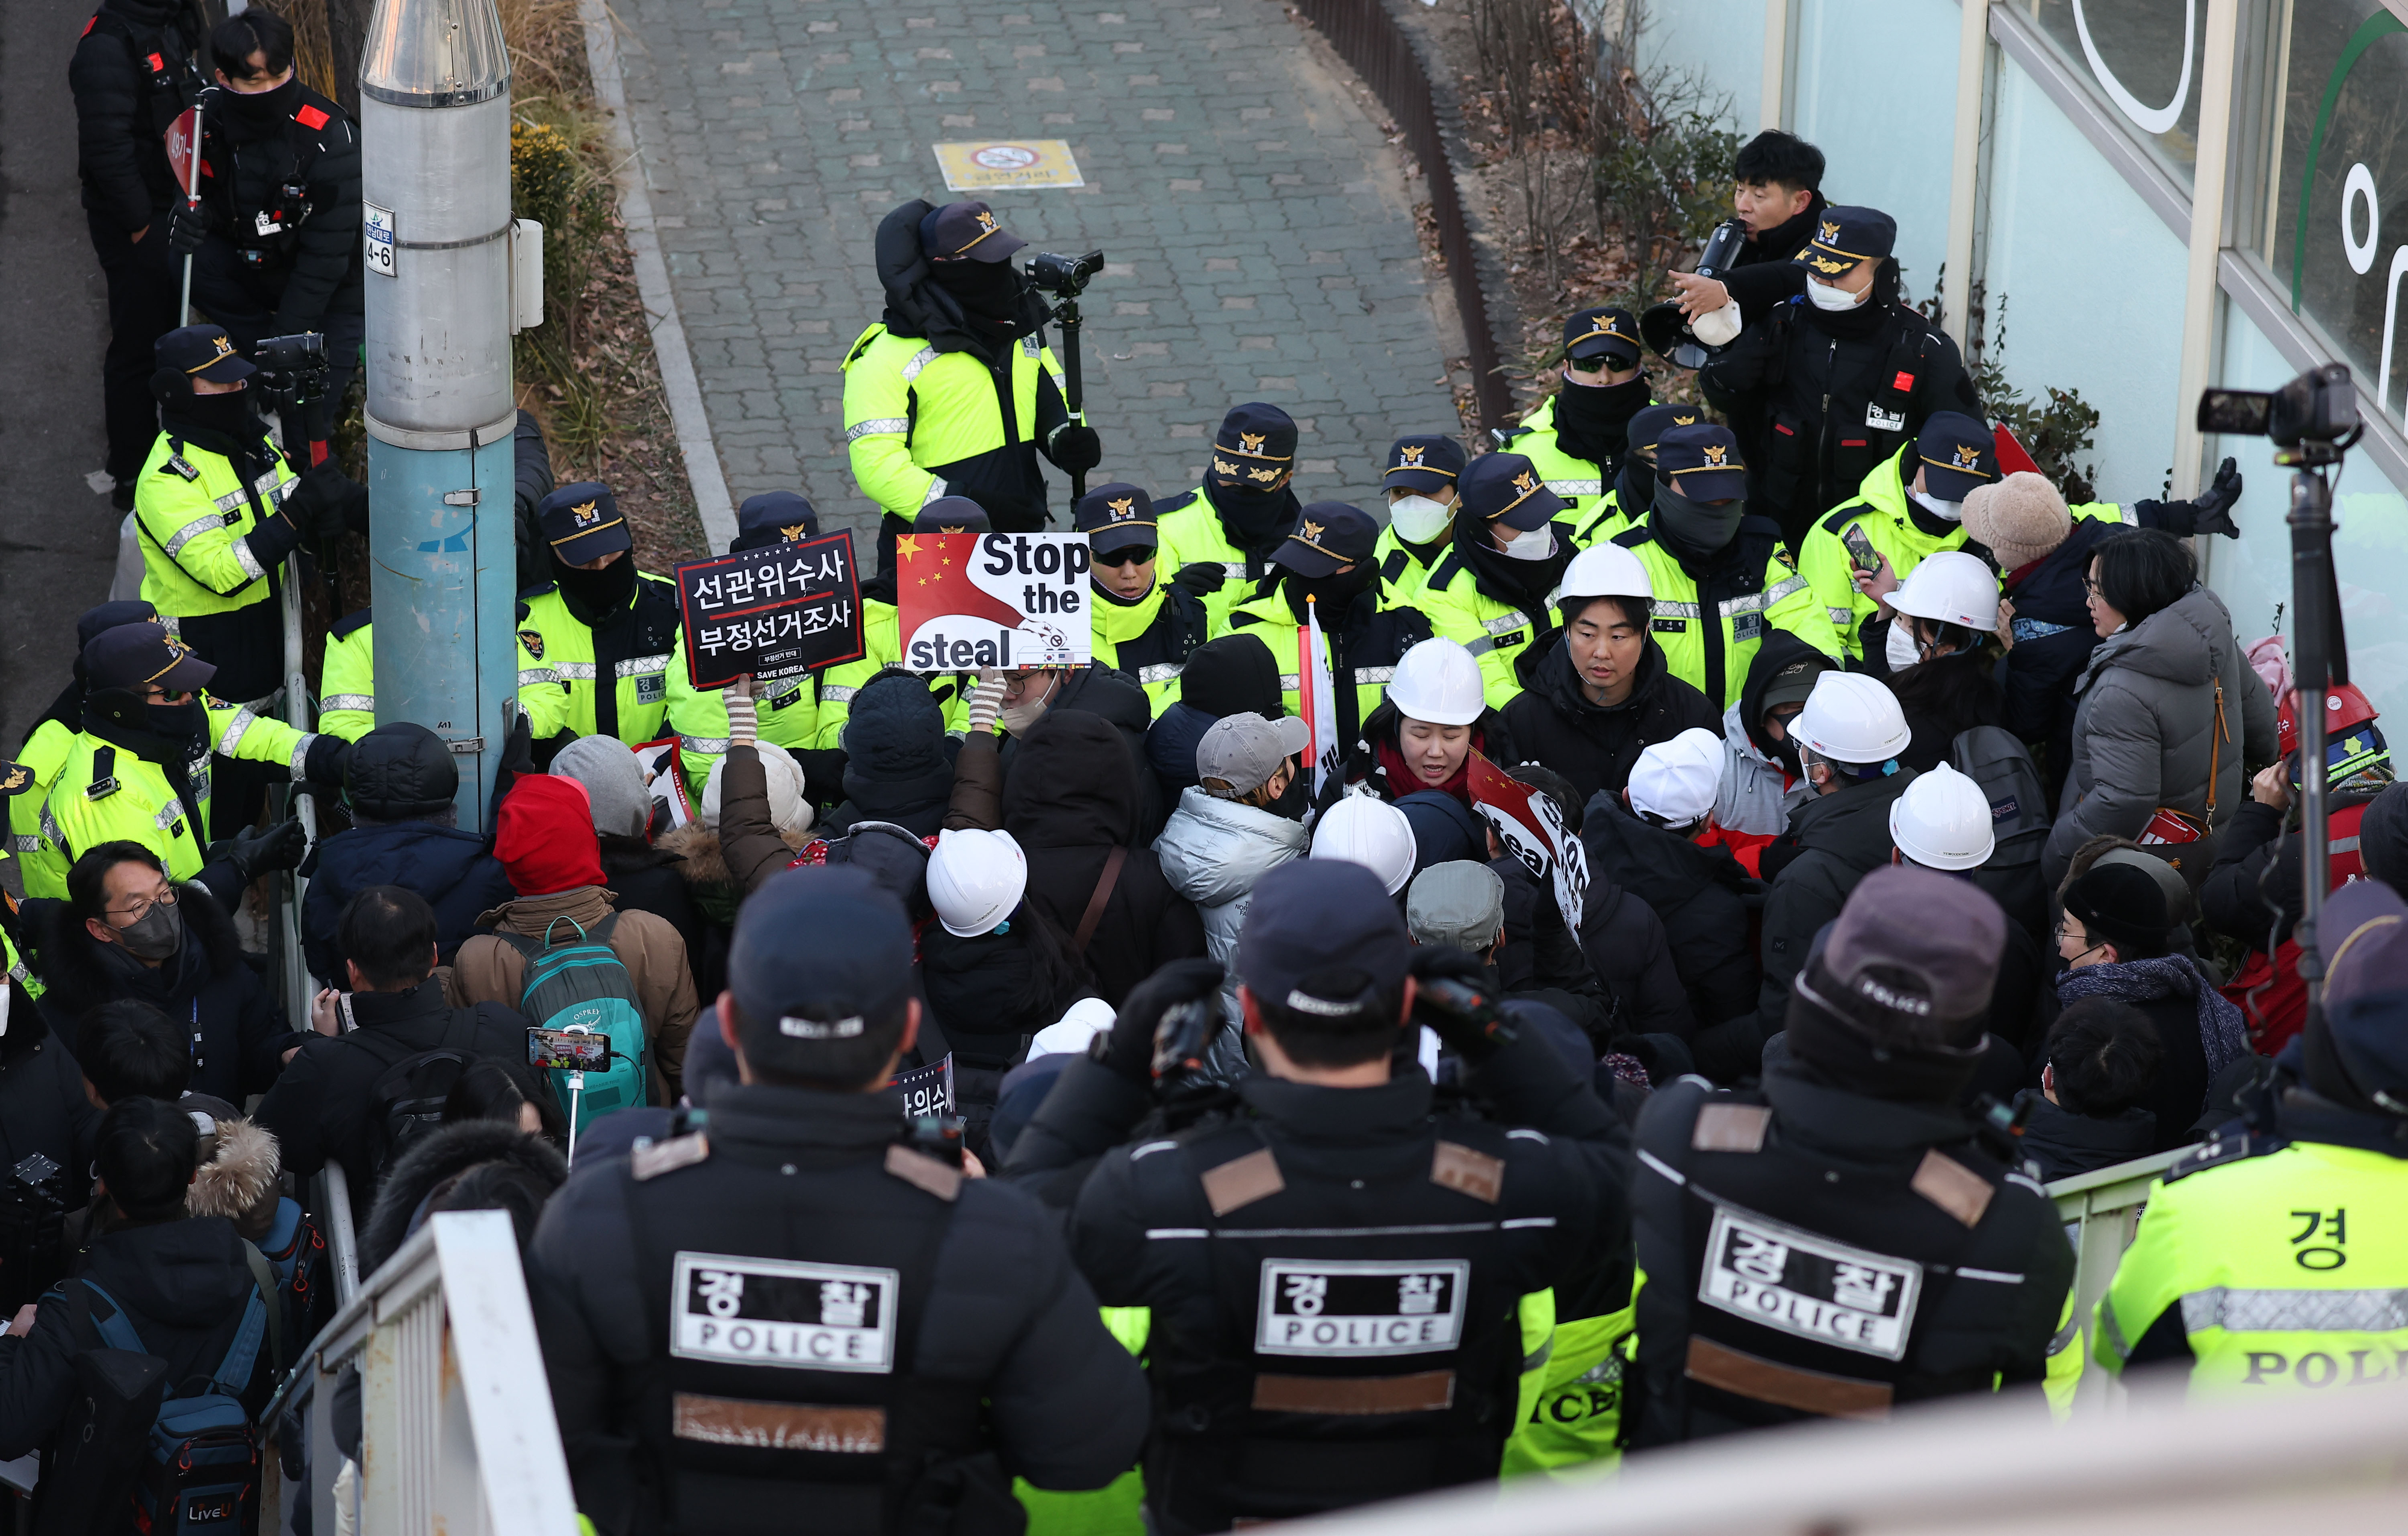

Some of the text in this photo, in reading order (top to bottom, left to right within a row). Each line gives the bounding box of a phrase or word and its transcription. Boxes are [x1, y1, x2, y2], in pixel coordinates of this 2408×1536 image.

[367, 225, 390, 242] 한남대로
[368, 242, 391, 267] 4-6
[1871, 419, 1899, 429] POLICE
[574, 509, 599, 523] 경찰
[984, 533, 1090, 585] Stop
[693, 549, 845, 611] 선관위수사
[1023, 583, 1079, 614] the
[699, 600, 851, 656] 부정선거조사
[1734, 629, 1758, 639] OLICE
[764, 650, 797, 663] 부정선거 반대
[911, 630, 1010, 668] steal
[757, 664, 805, 679] SAVE KOREA
[641, 690, 665, 701] POLIC
[677, 786, 686, 806] KOREA
[1992, 802, 2017, 818] SPORT
[1862, 979, 1931, 1016] POLICE
[574, 1008, 600, 1021] OSPREY
[1733, 1230, 1895, 1315] 경찰
[698, 1271, 871, 1326] 경찰
[1284, 1273, 1445, 1316] 경찰
[1731, 1278, 1875, 1343] POLICE
[701, 1323, 863, 1360] POLICE
[1285, 1318, 1436, 1345] POLICE
[1529, 1391, 1616, 1425] ICE
[189, 1502, 231, 1520] LiveU
